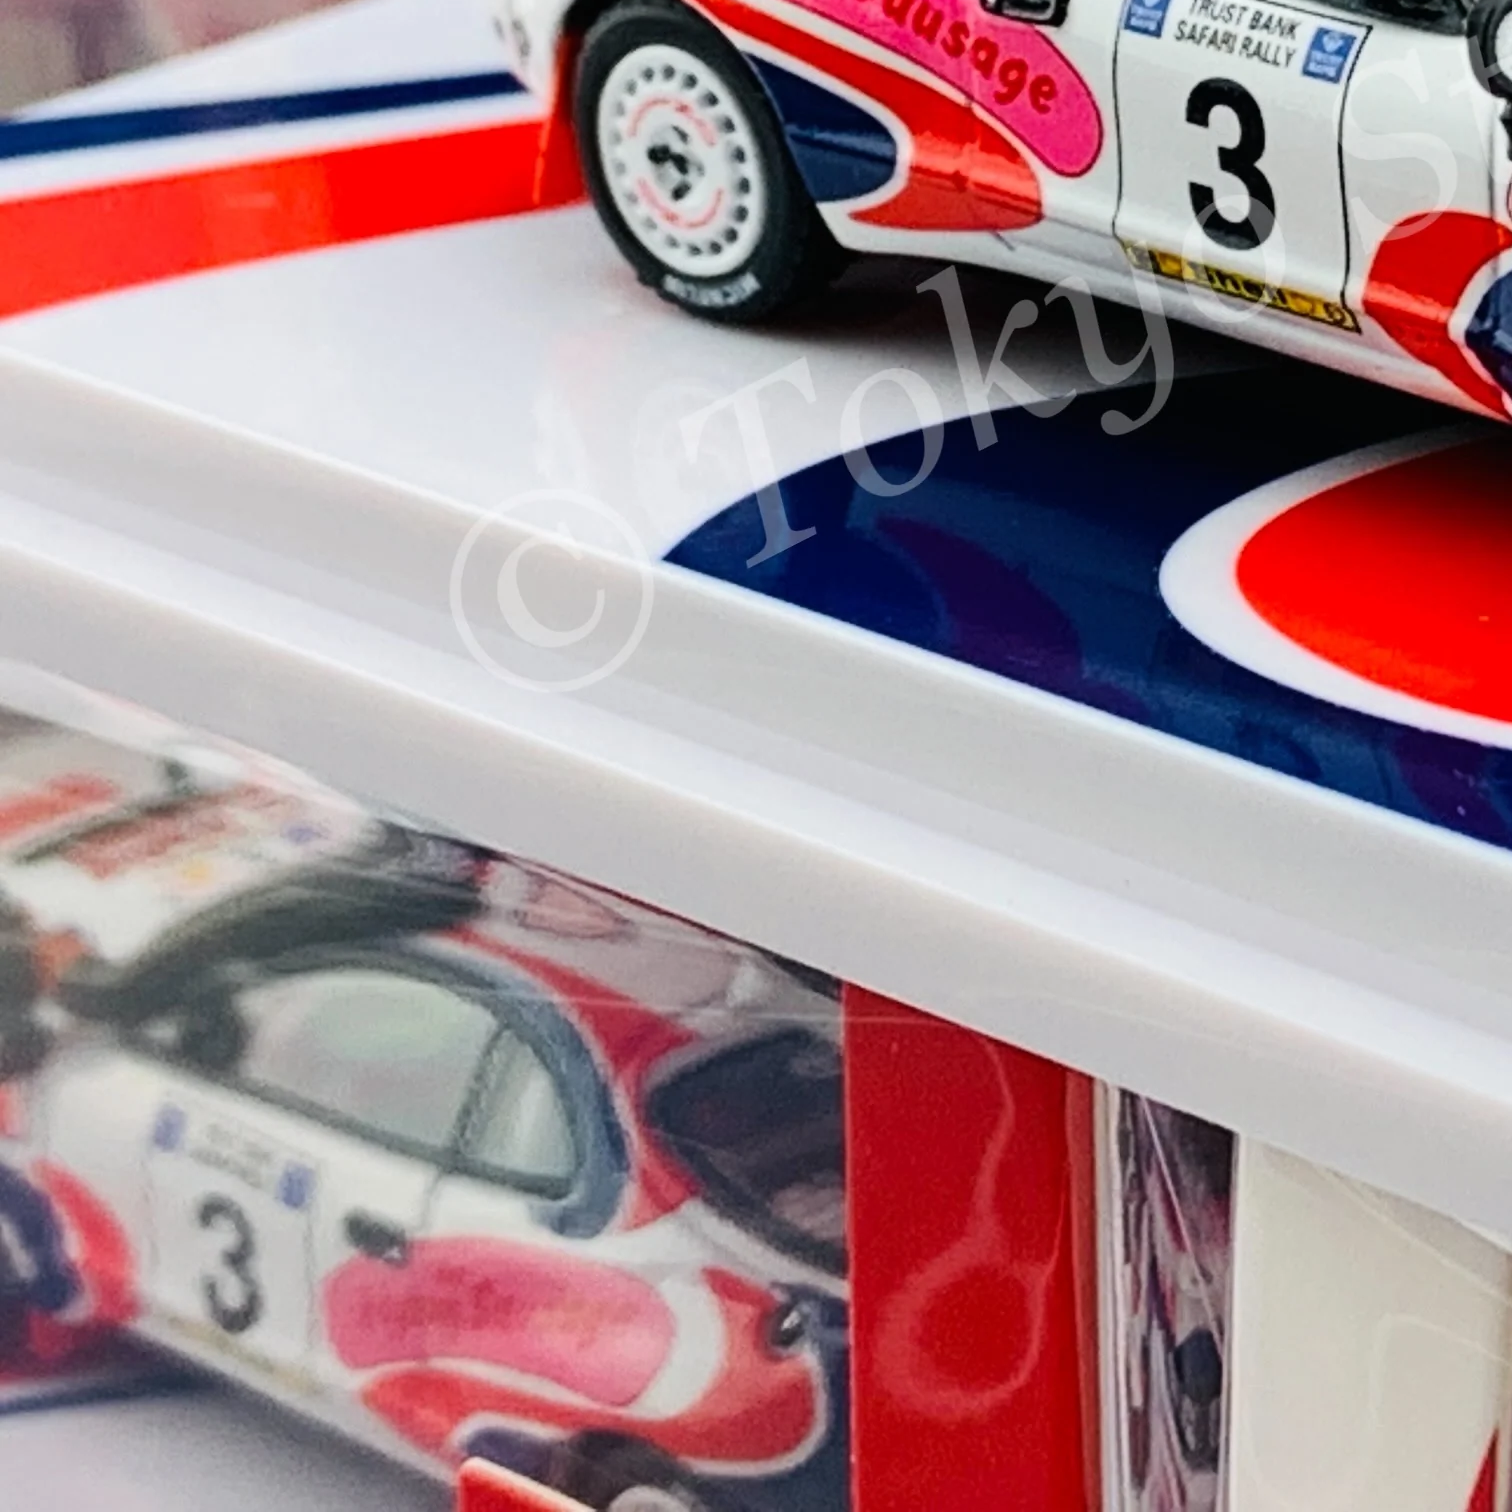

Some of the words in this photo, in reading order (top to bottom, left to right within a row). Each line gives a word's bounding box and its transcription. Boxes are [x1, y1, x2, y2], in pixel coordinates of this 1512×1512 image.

[1173, 19, 1237, 55] SAFARI
[1238, 37, 1297, 69] RALLY
[1249, 9, 1303, 40] BANK
[1184, 77, 1278, 251] 3
[197, 1191, 263, 1335] 3
